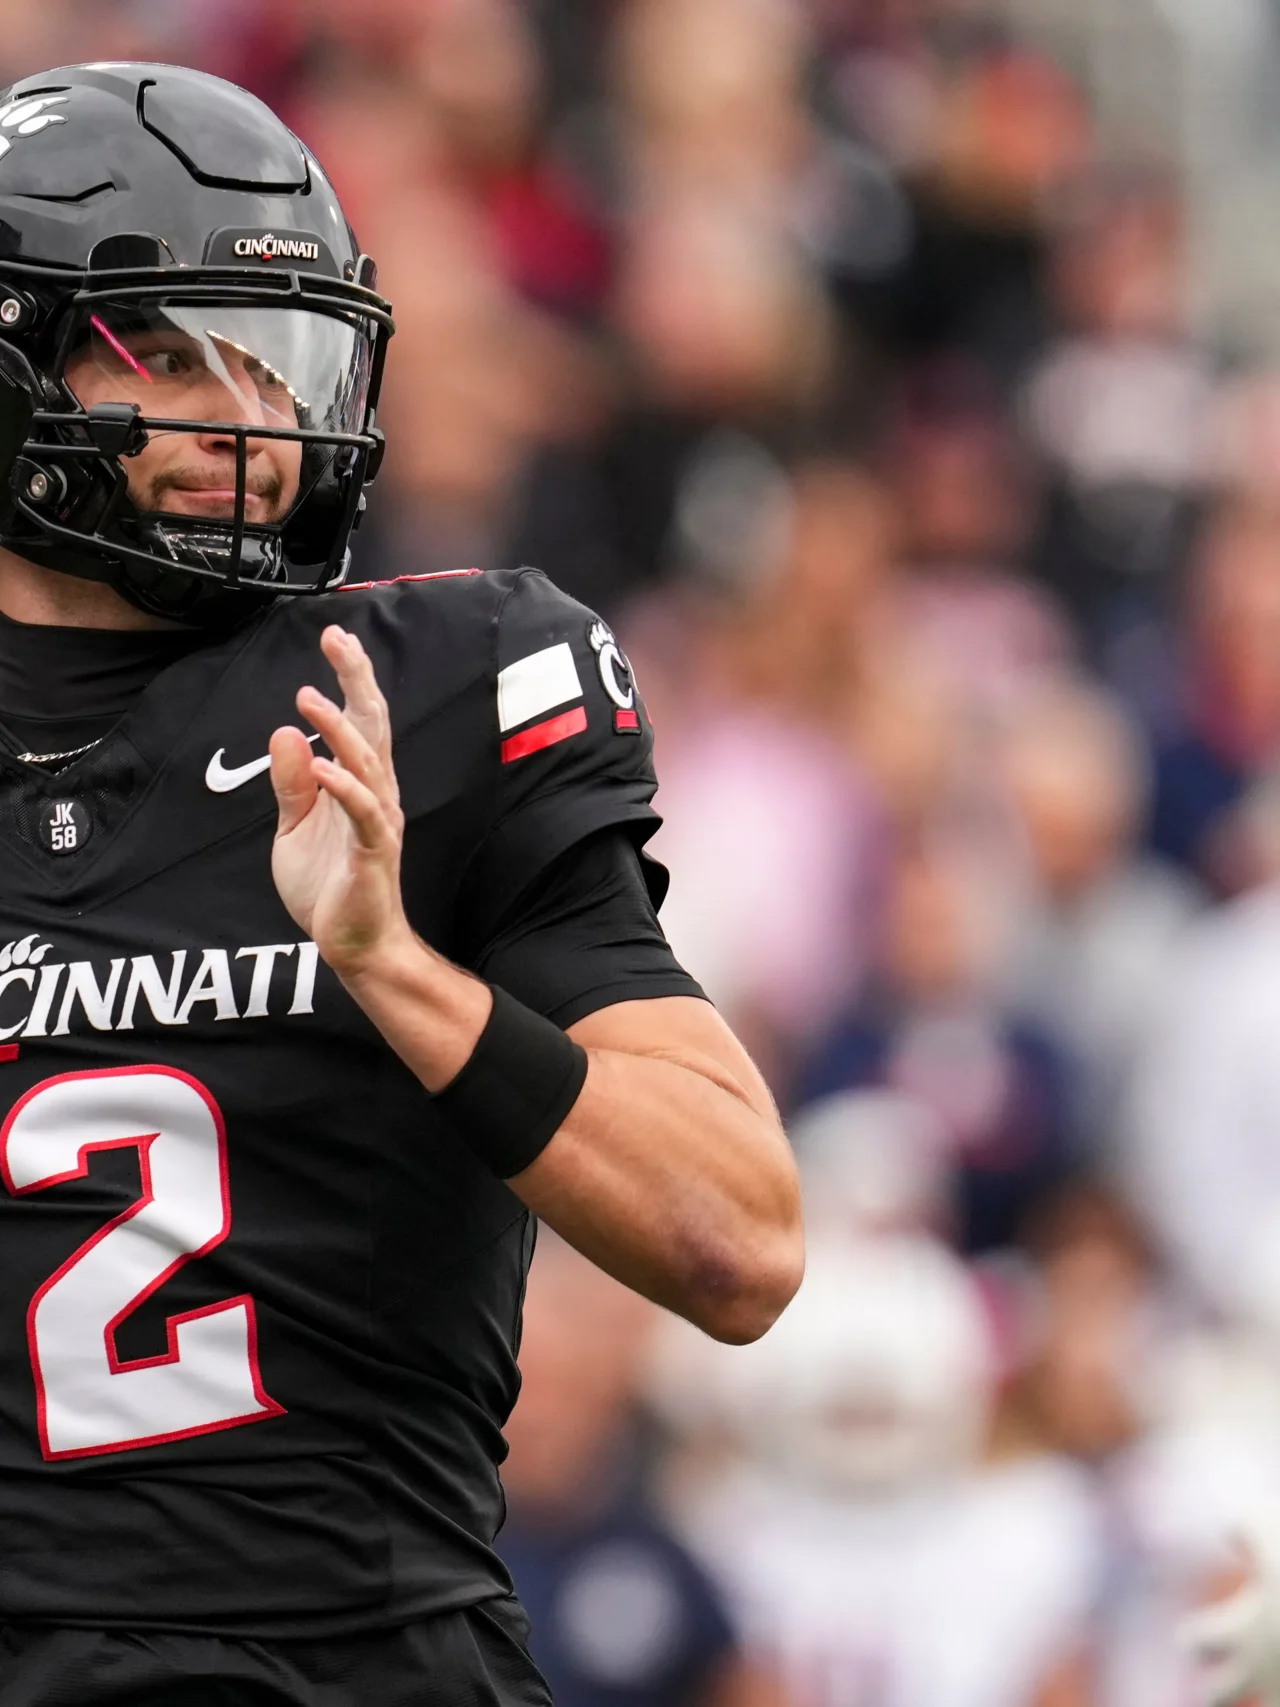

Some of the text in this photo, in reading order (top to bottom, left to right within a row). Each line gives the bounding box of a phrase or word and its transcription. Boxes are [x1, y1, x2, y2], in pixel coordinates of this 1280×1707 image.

[234, 233, 319, 259] CINCINNATI
[590, 622, 634, 709] C
[49, 802, 75, 826] JK
[51, 825, 77, 850] 58
